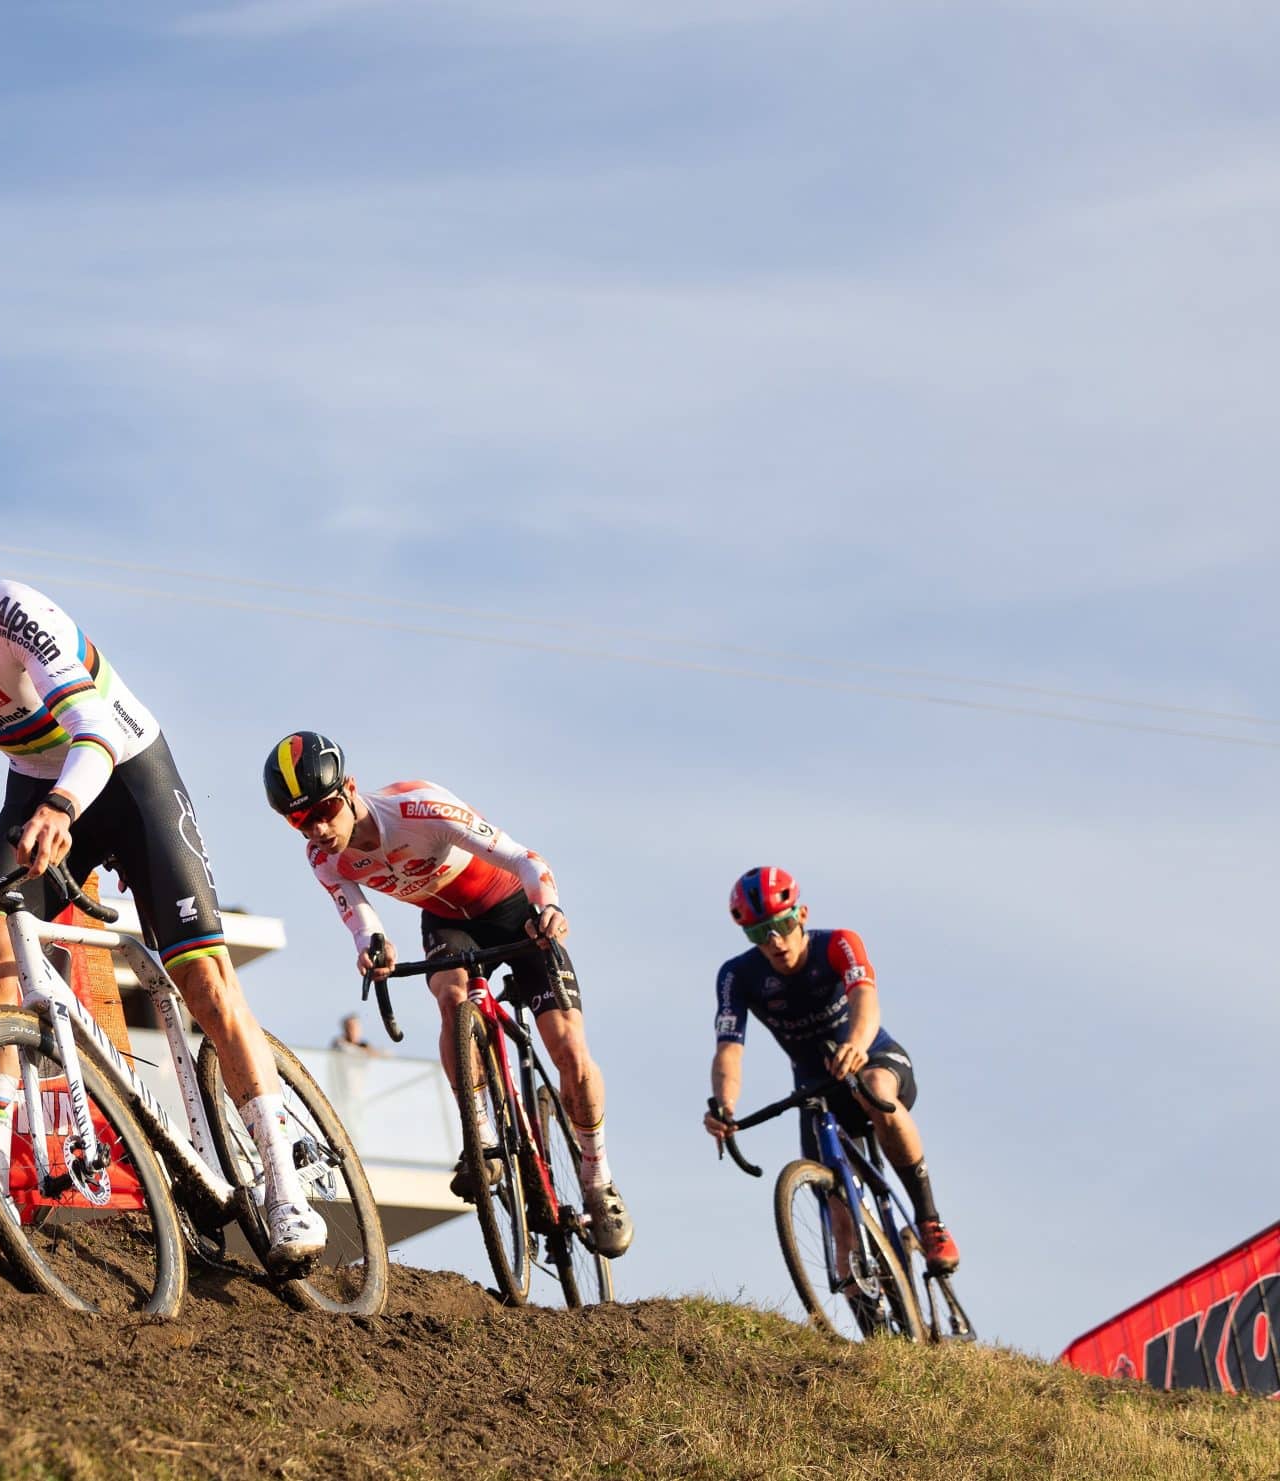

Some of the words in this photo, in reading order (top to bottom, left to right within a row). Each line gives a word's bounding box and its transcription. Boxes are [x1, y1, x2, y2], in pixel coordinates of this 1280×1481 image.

[10, 633, 49, 667] BOOSTER
[113, 699, 145, 739] deceuninck
[478, 823, 494, 836] 9
[337, 895, 348, 913] 9
